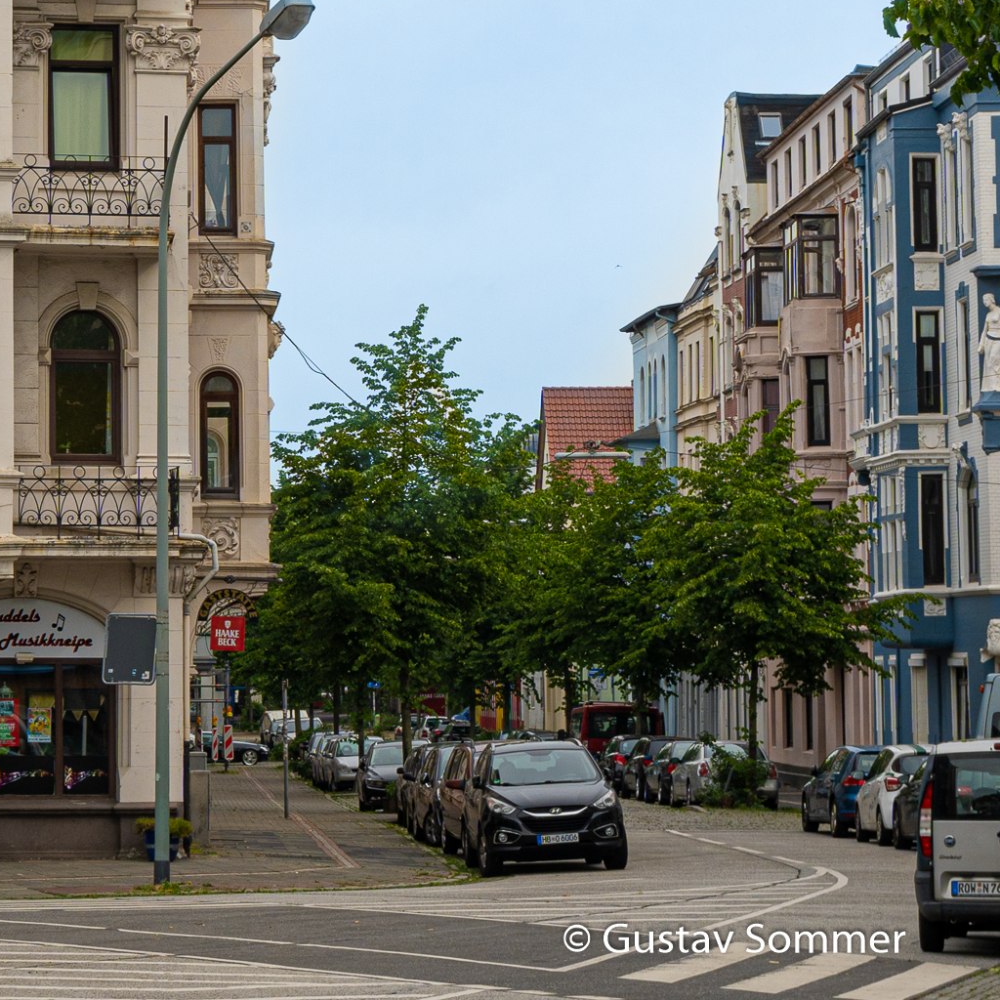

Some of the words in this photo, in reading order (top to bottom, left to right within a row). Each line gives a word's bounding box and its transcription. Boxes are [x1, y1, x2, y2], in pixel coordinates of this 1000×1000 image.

[215, 629, 240, 638] HAAKE
[217, 638, 237, 647] BECK
[958, 882, 976, 893] ROW
[983, 883, 989, 893] N
